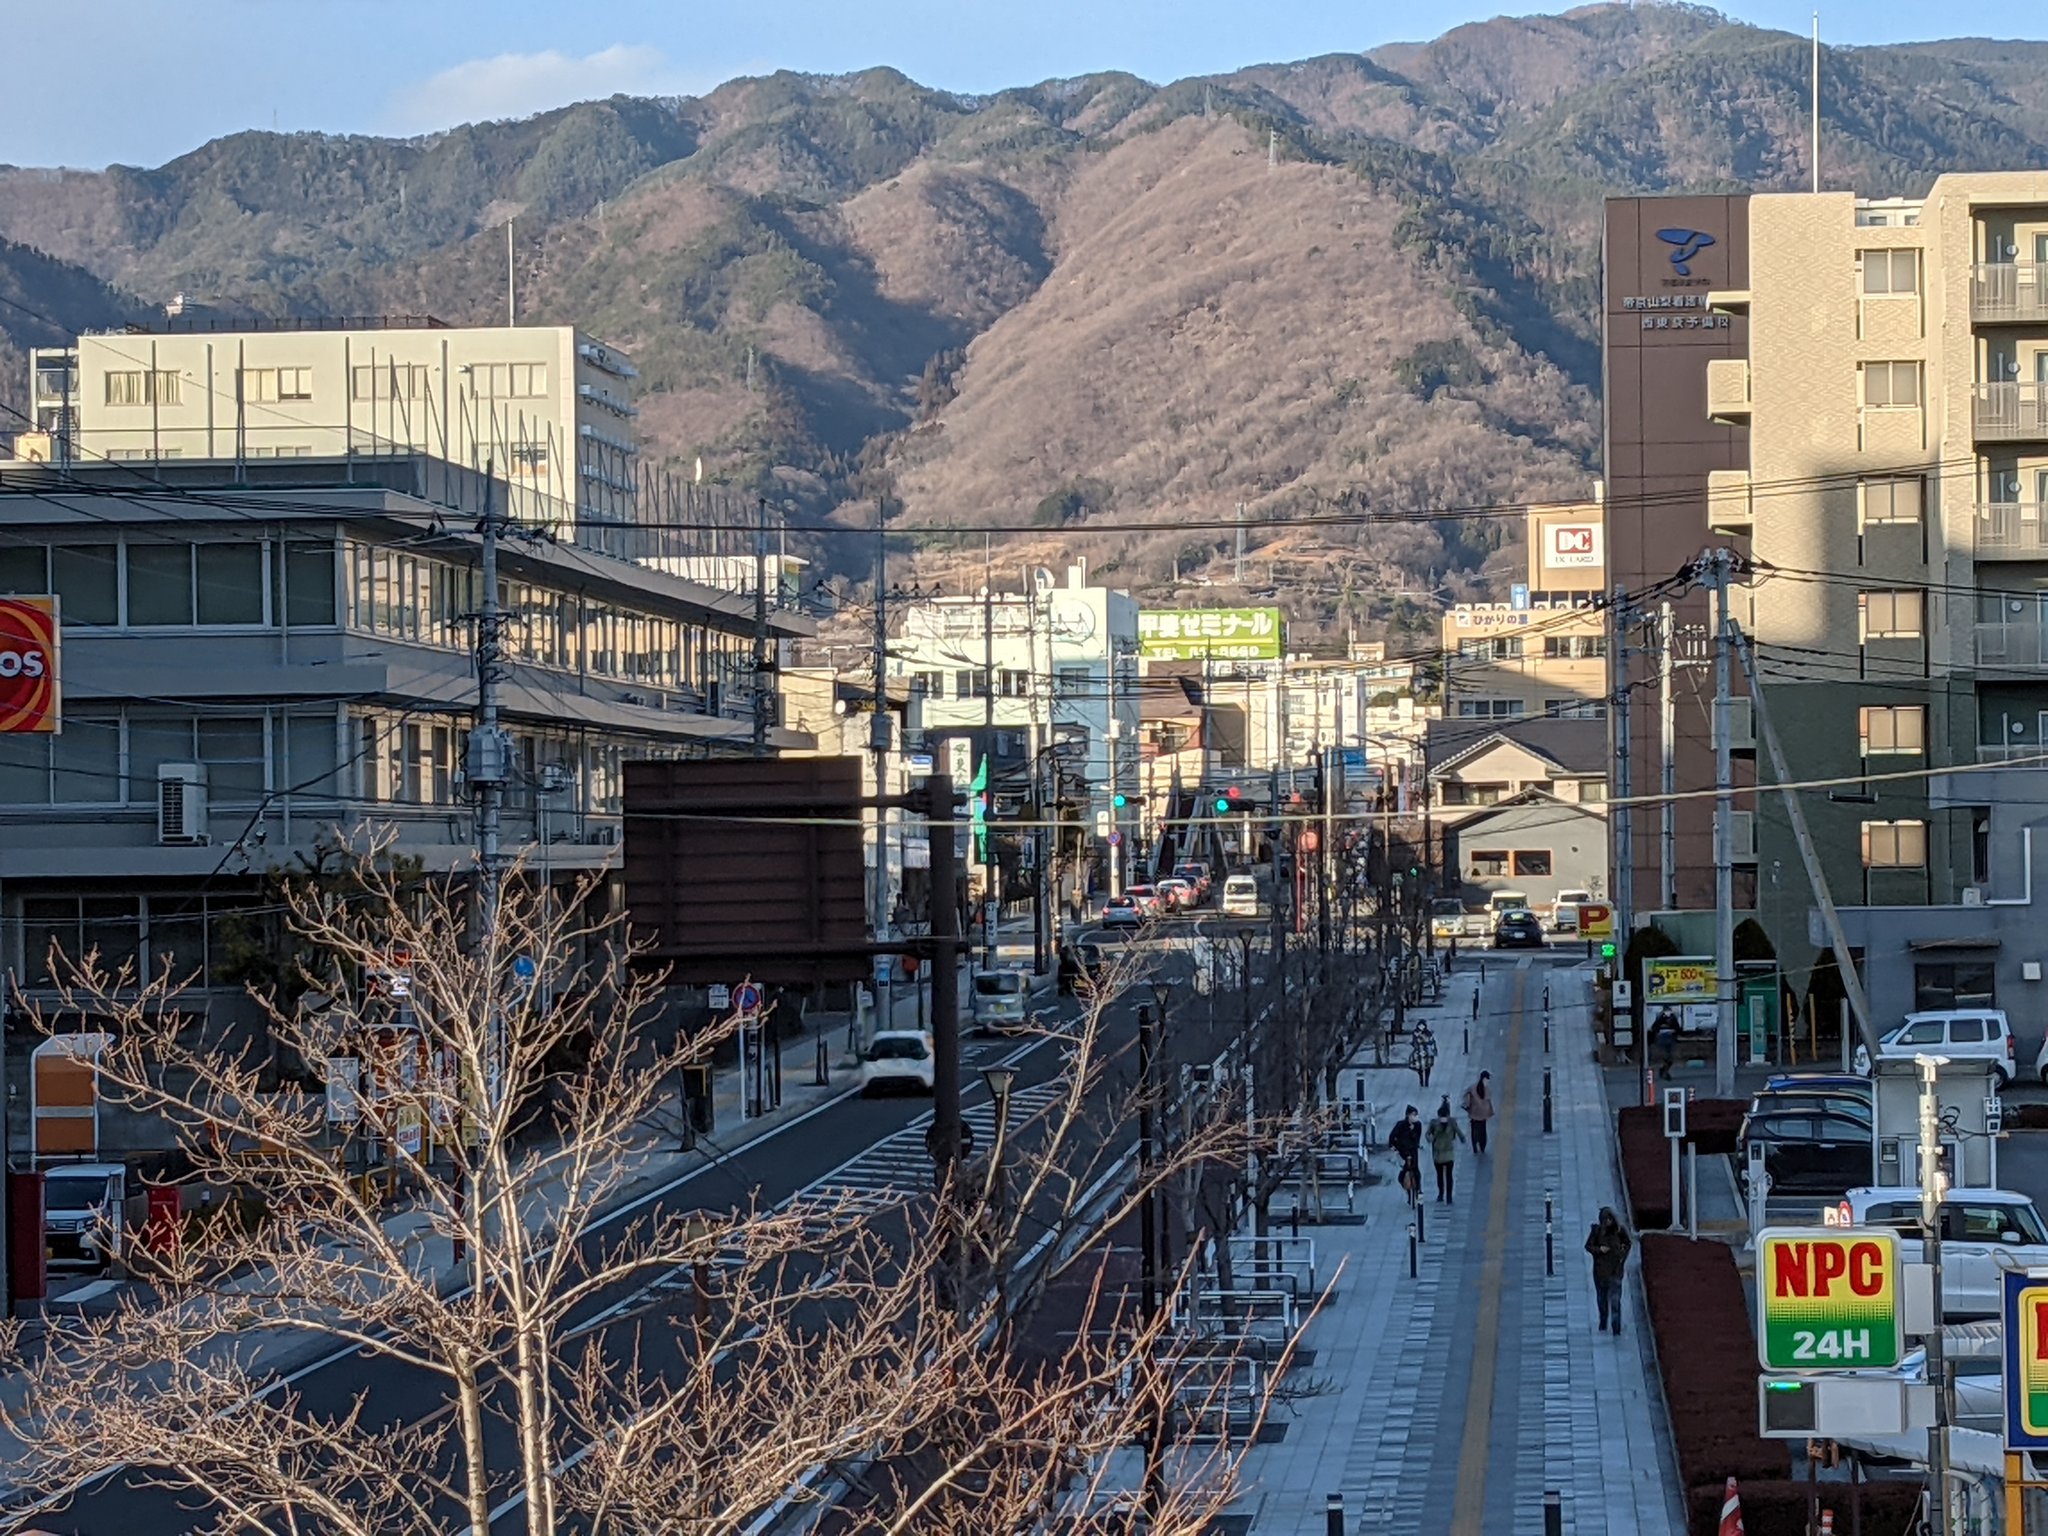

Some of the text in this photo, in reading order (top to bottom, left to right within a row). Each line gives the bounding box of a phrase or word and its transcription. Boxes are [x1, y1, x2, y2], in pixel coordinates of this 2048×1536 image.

[1139, 612, 1273, 638] 甲斐ゼミナール
[1579, 905, 1610, 930] P
[1774, 1242, 1884, 1298] NPC
[1793, 1329, 1871, 1360] 24H
